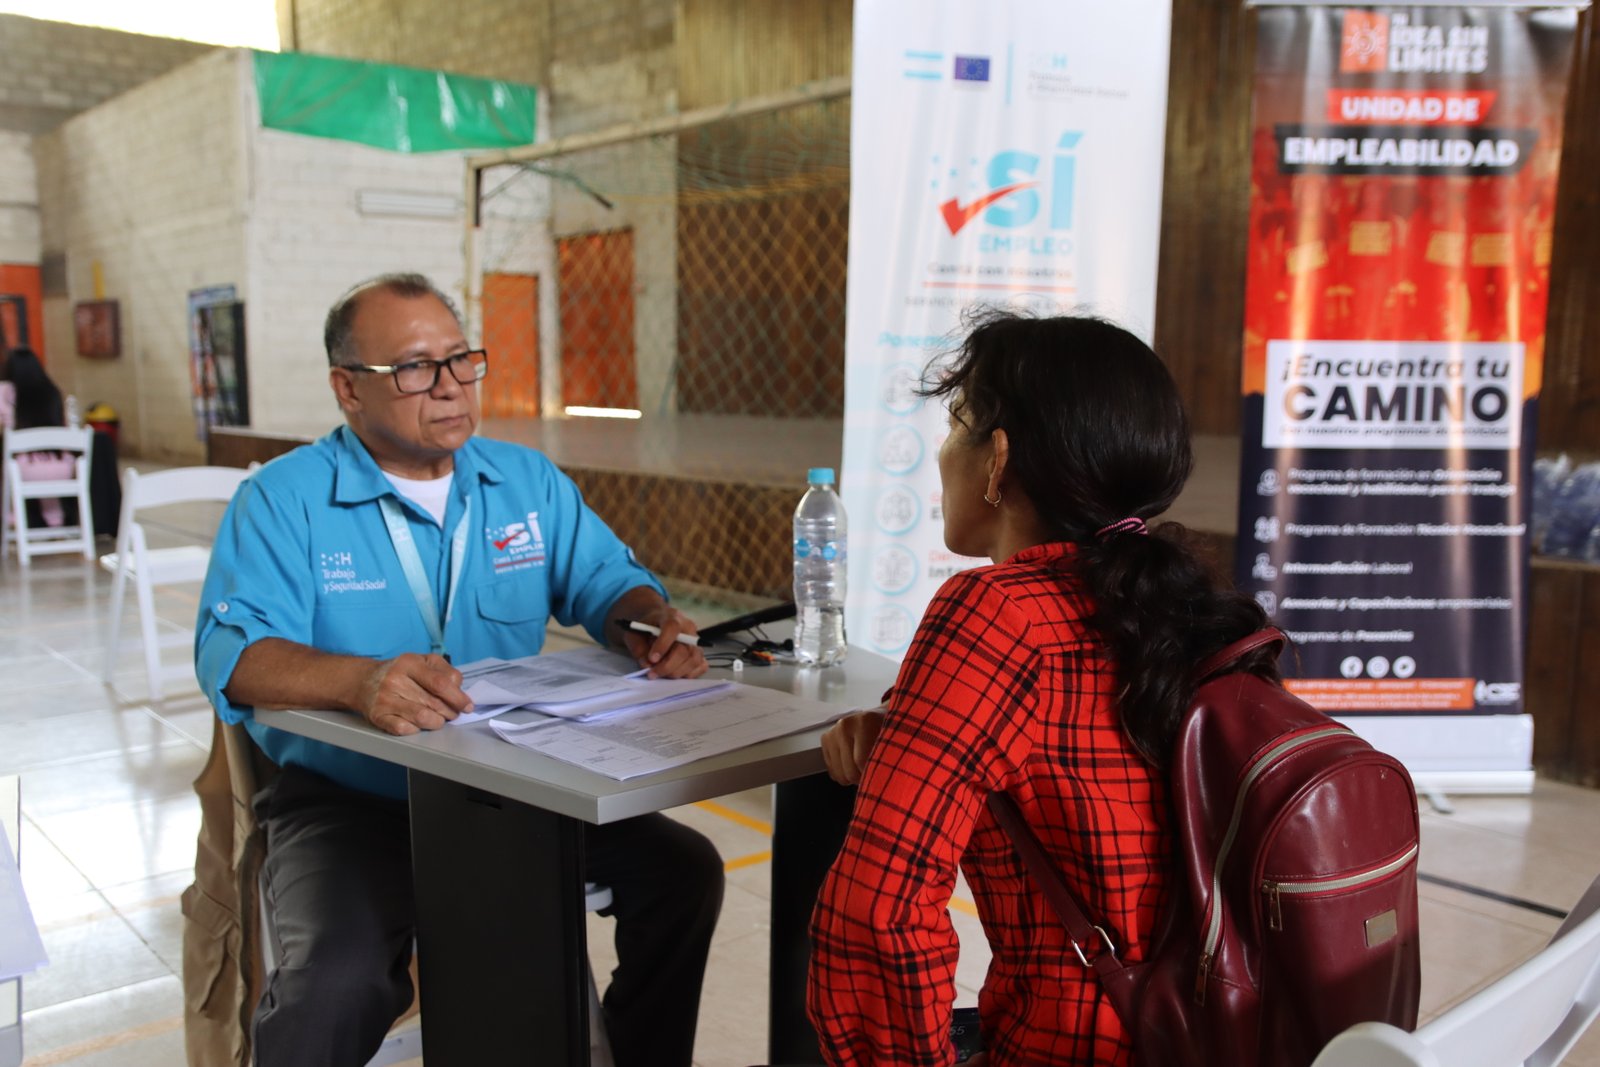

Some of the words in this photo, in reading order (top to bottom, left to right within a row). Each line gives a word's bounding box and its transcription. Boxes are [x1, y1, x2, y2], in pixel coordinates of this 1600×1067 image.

[1389, 46, 1488, 73] LIMITES
[1342, 96, 1442, 121] UNIDAD
[1446, 97, 1479, 121] DE
[1284, 137, 1520, 167] EMPLEABILIDAD
[979, 234, 1073, 255] EMPLEO
[1476, 356, 1511, 379] tu
[1284, 385, 1509, 422] CAMINO
[322, 569, 356, 581] Trabajo
